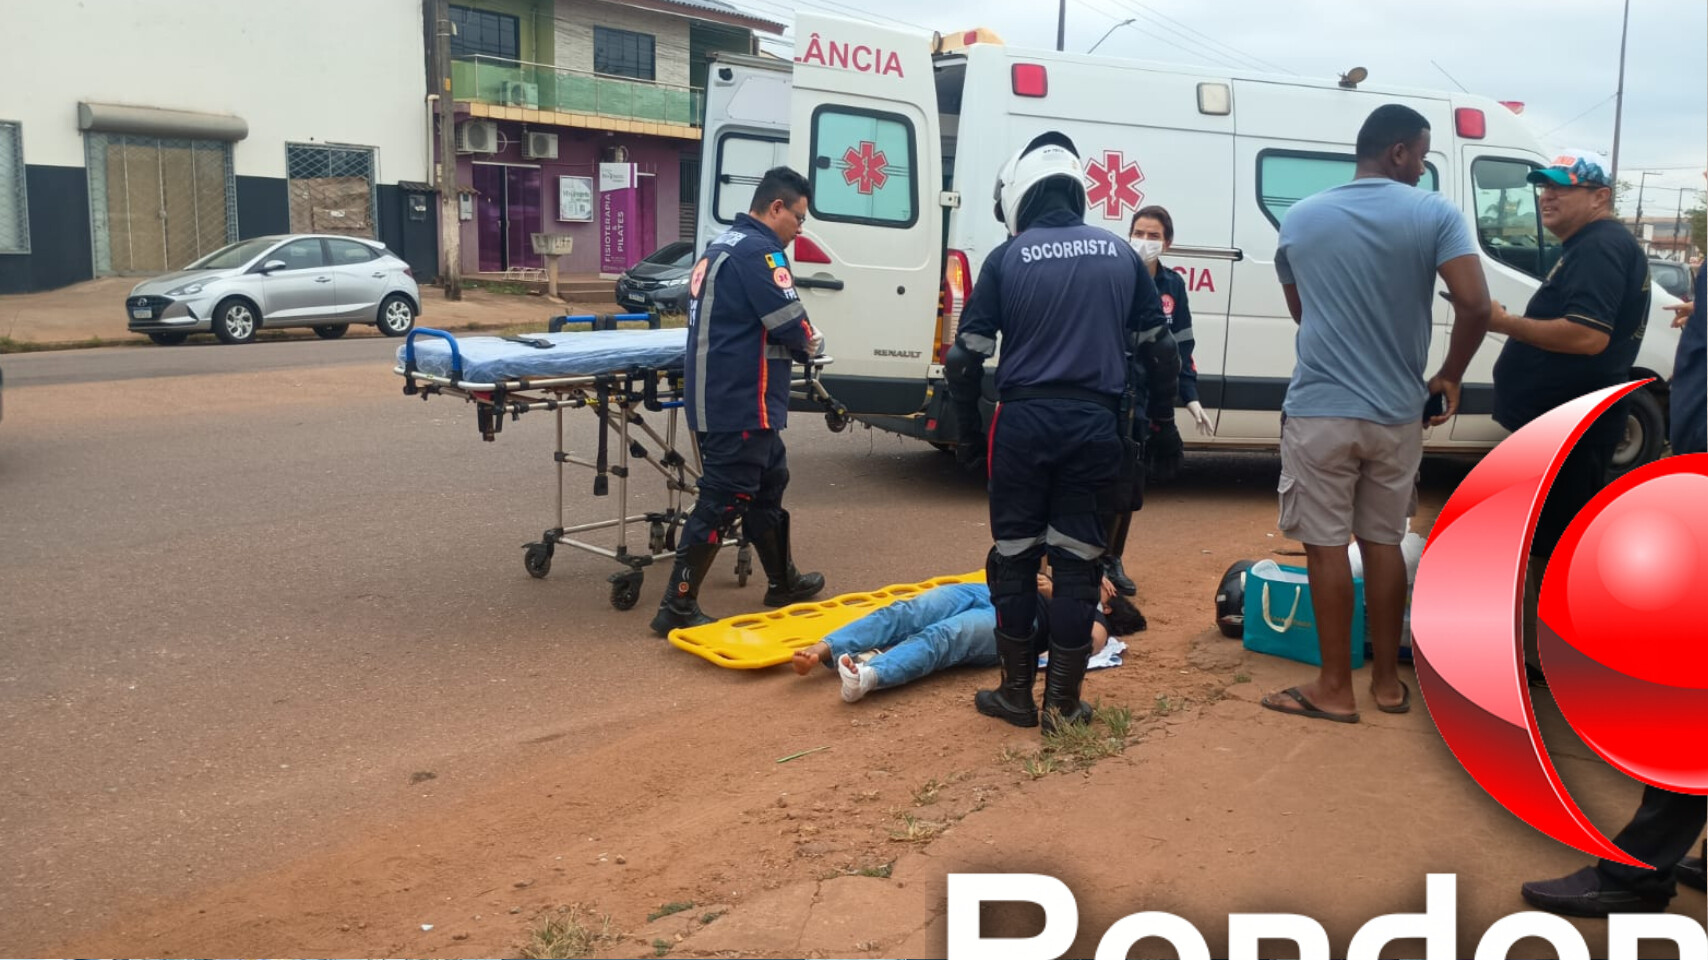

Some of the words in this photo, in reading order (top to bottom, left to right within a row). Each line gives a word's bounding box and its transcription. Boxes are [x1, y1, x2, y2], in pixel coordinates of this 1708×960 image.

[604, 193, 612, 262] FISIOTERAPIA
[617, 211, 625, 252] PILATES
[1020, 239, 1118, 263] SOCORRISTA
[873, 348, 922, 358] RENAULT
